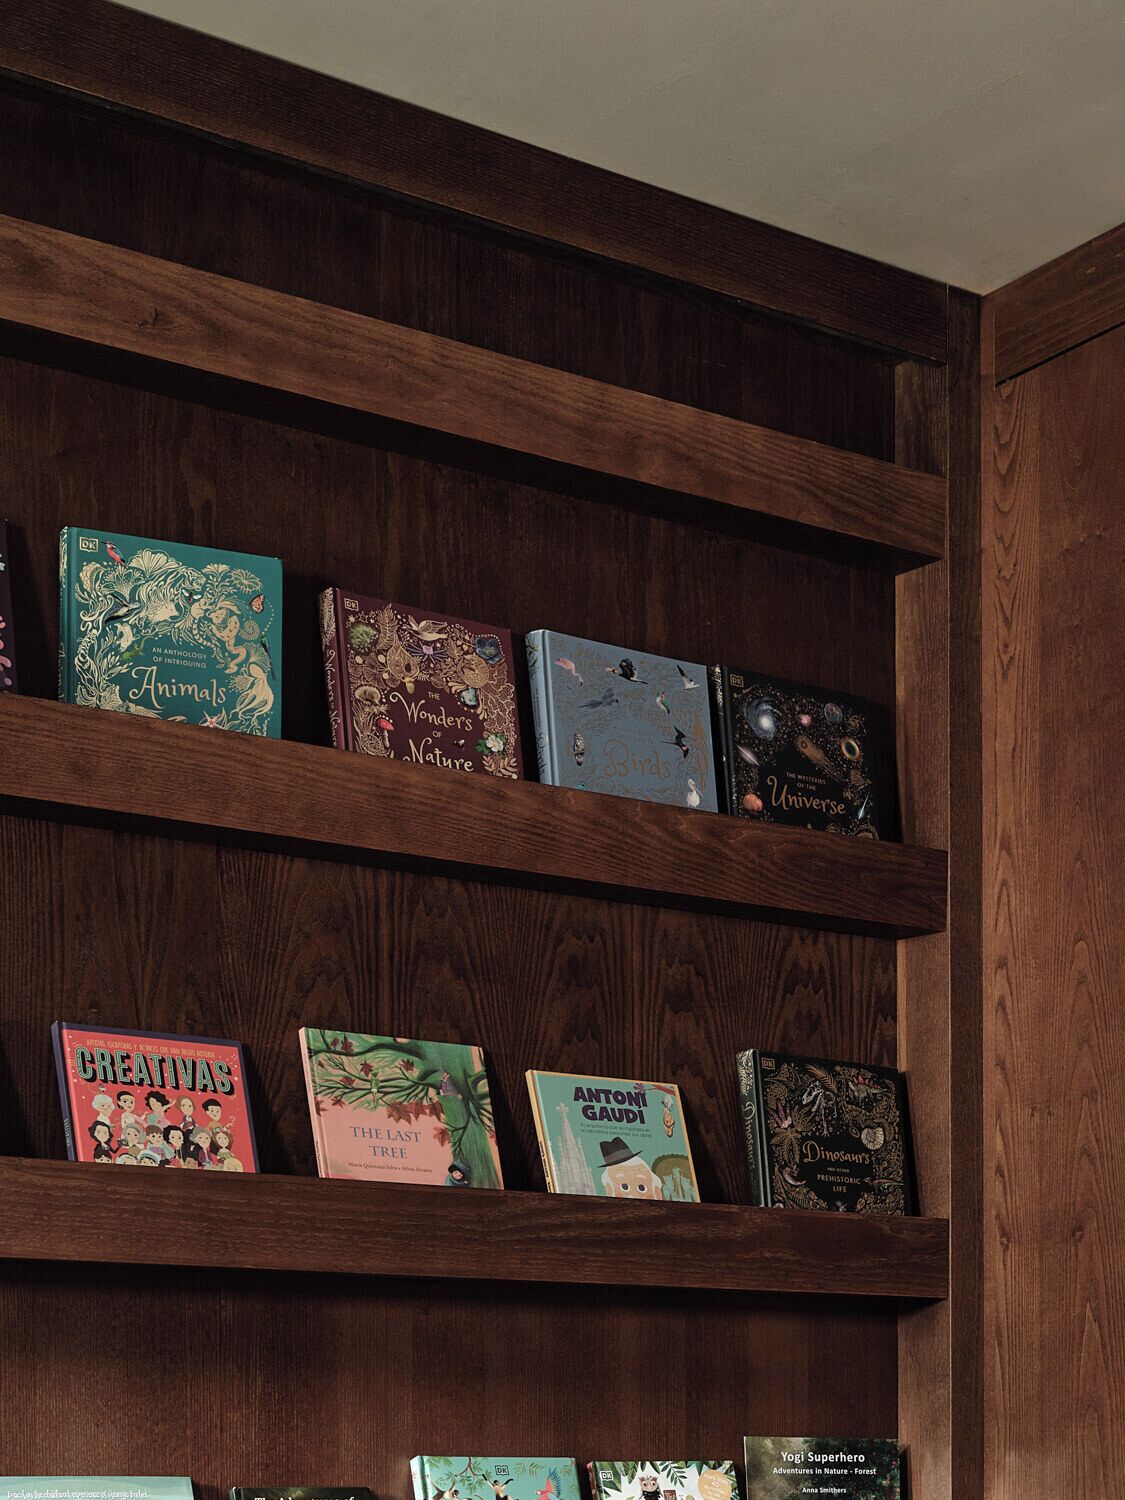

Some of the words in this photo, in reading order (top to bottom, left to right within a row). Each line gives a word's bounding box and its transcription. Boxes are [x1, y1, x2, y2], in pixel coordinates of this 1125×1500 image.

[81, 540, 97, 549] DK
[164, 648, 207, 660] ANTHOLOGY
[165, 658, 207, 669] INTRIGUING
[129, 666, 226, 709] Animals
[428, 691, 440, 700] THE
[390, 692, 473, 731] Wonders
[433, 730, 442, 738] OF
[402, 737, 474, 772] Nature
[604, 739, 672, 780] Birds
[797, 773, 826, 785] MYSTERIES
[767, 775, 847, 815] Universe
[75, 1046, 235, 1095] CREATIVAS
[573, 1086, 648, 1108] ANTONI
[349, 1126, 383, 1140] THE
[387, 1129, 421, 1143] LAST
[369, 1145, 408, 1159] TREE
[802, 1141, 870, 1164] Dinosaurs
[817, 1174, 861, 1185] PREHISTORIC
[781, 1451, 804, 1464] Yogi
[808, 1452, 865, 1465] Superhero
[602, 1472, 612, 1480] DK
[773, 1467, 814, 1475] Adventures
[815, 1467, 823, 1475] in
